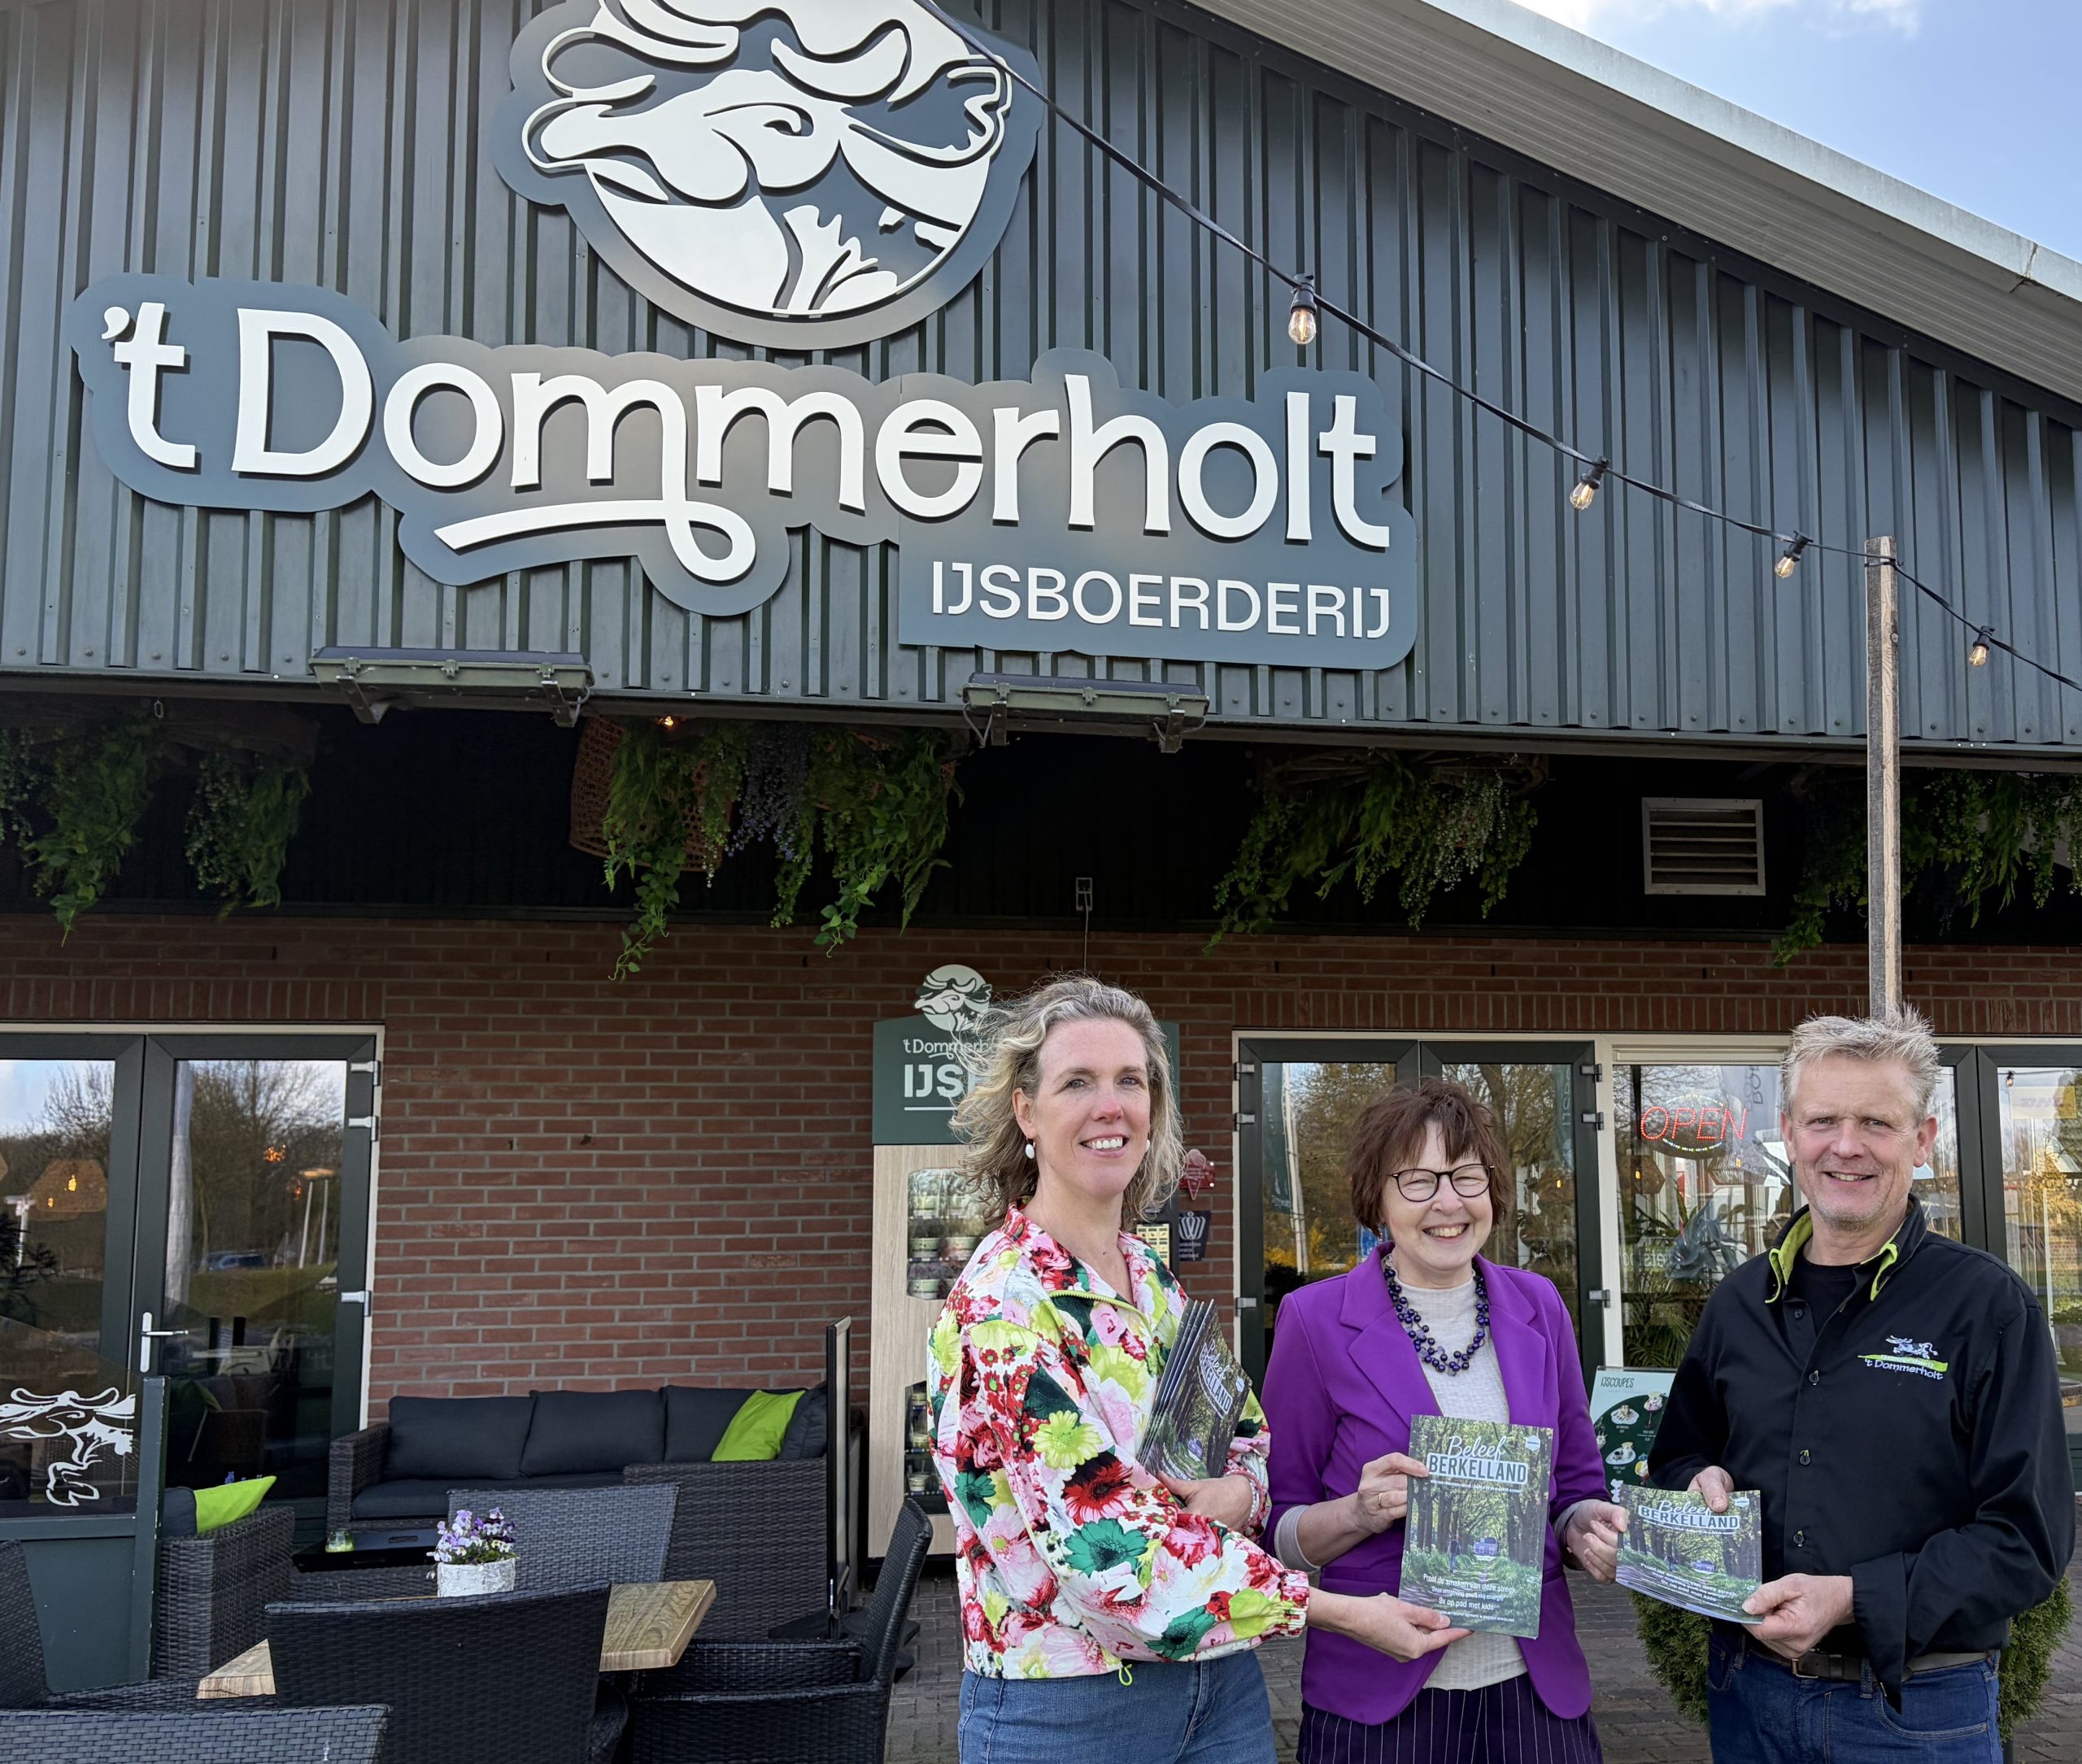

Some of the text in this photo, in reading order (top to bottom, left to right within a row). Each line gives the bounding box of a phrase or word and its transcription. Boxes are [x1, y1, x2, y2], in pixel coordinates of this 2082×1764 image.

[101, 302, 1390, 581] 't Dommerholt
[933, 561, 1391, 639] IJSBOERDERIJ
[1640, 1106, 1747, 1140] OPEN
[1874, 1359, 1944, 1380] Dommerholt
[1601, 1376, 1635, 1388] IJSCOUPES
[1448, 1435, 1508, 1462] Beleef
[1429, 1454, 1527, 1483] BERKELLAND
[1641, 1506, 1739, 1528] BERKELLAND
[1437, 1576, 1445, 1584] de
[1482, 1583, 1496, 1592] deze
[1497, 1585, 1516, 1594] streek
[1447, 1599, 1455, 1608] op
[1456, 1600, 1467, 1608] pad
[1481, 1602, 1495, 1610] kids
